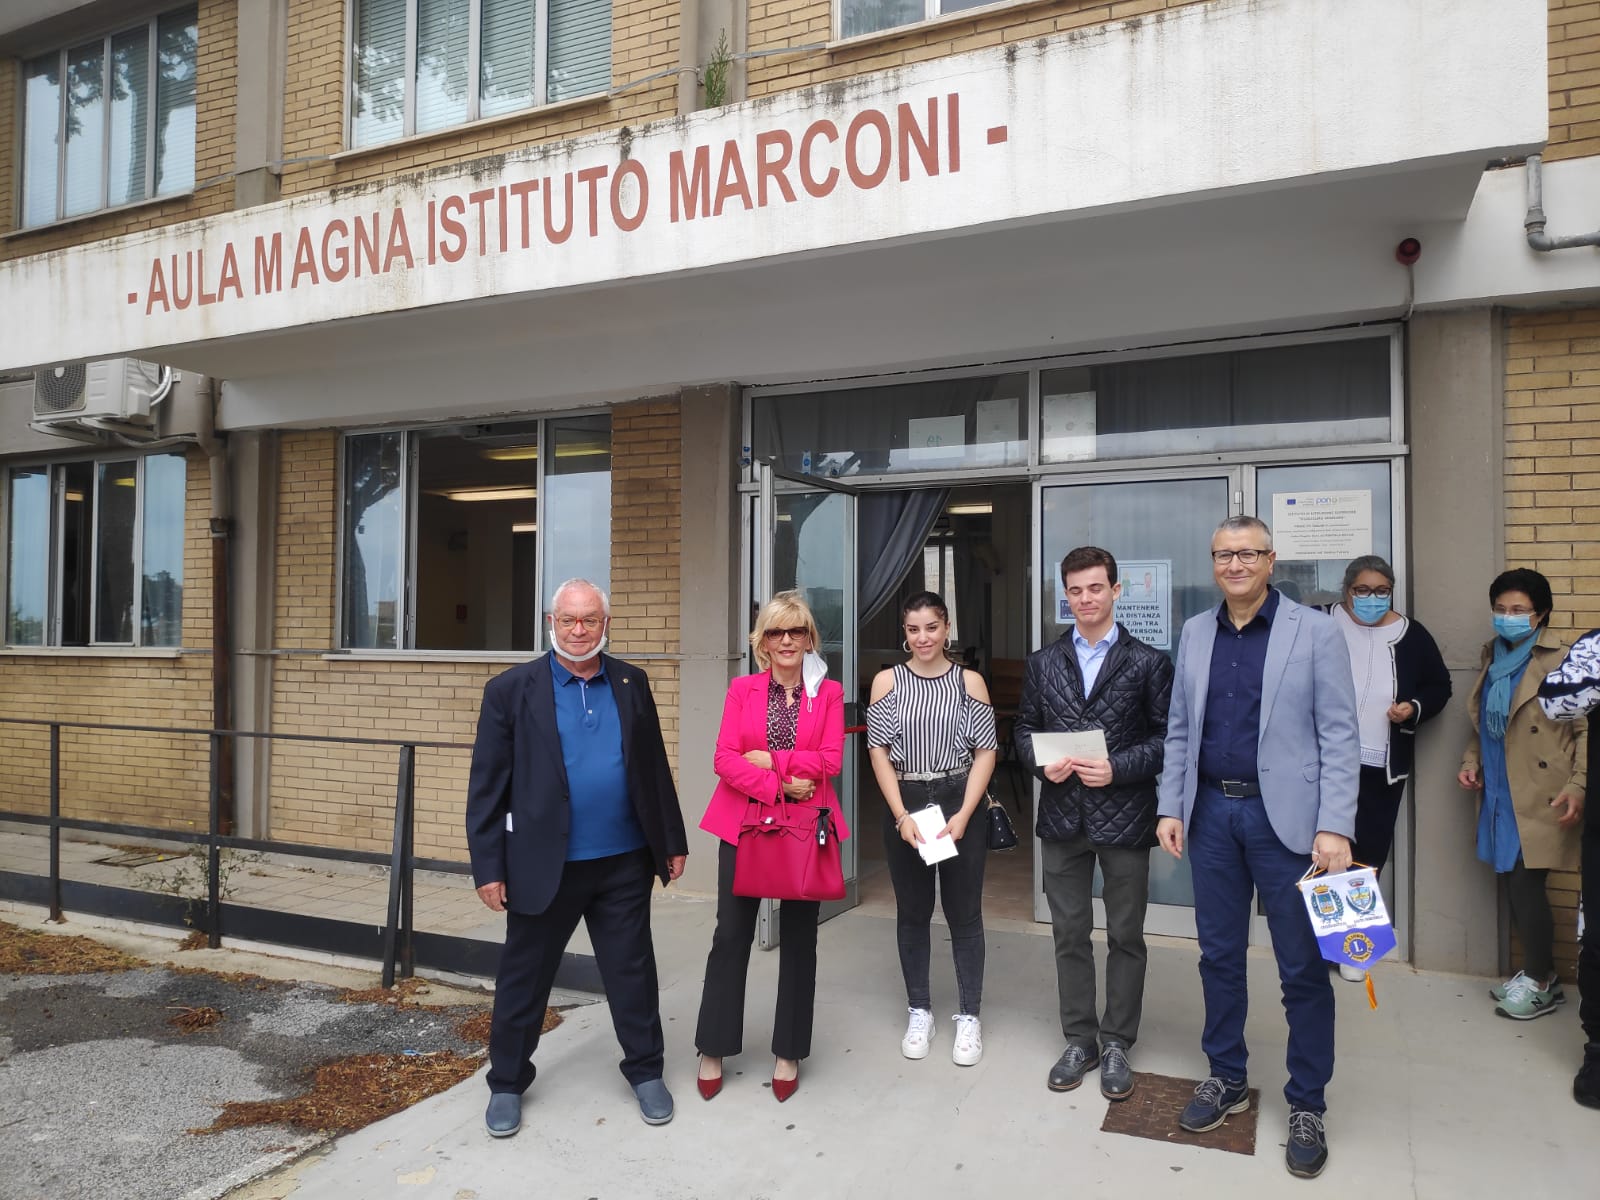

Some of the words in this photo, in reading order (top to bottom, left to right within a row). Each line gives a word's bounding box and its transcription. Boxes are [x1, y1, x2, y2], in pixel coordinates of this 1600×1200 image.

[127, 292, 137, 304] -
[147, 243, 243, 315] AULA
[255, 207, 414, 296] MAGNA
[427, 159, 649, 266] ISTITUTO
[669, 93, 961, 223] MARCONI
[987, 126, 1008, 145] -
[1352, 940, 1364, 952] L
